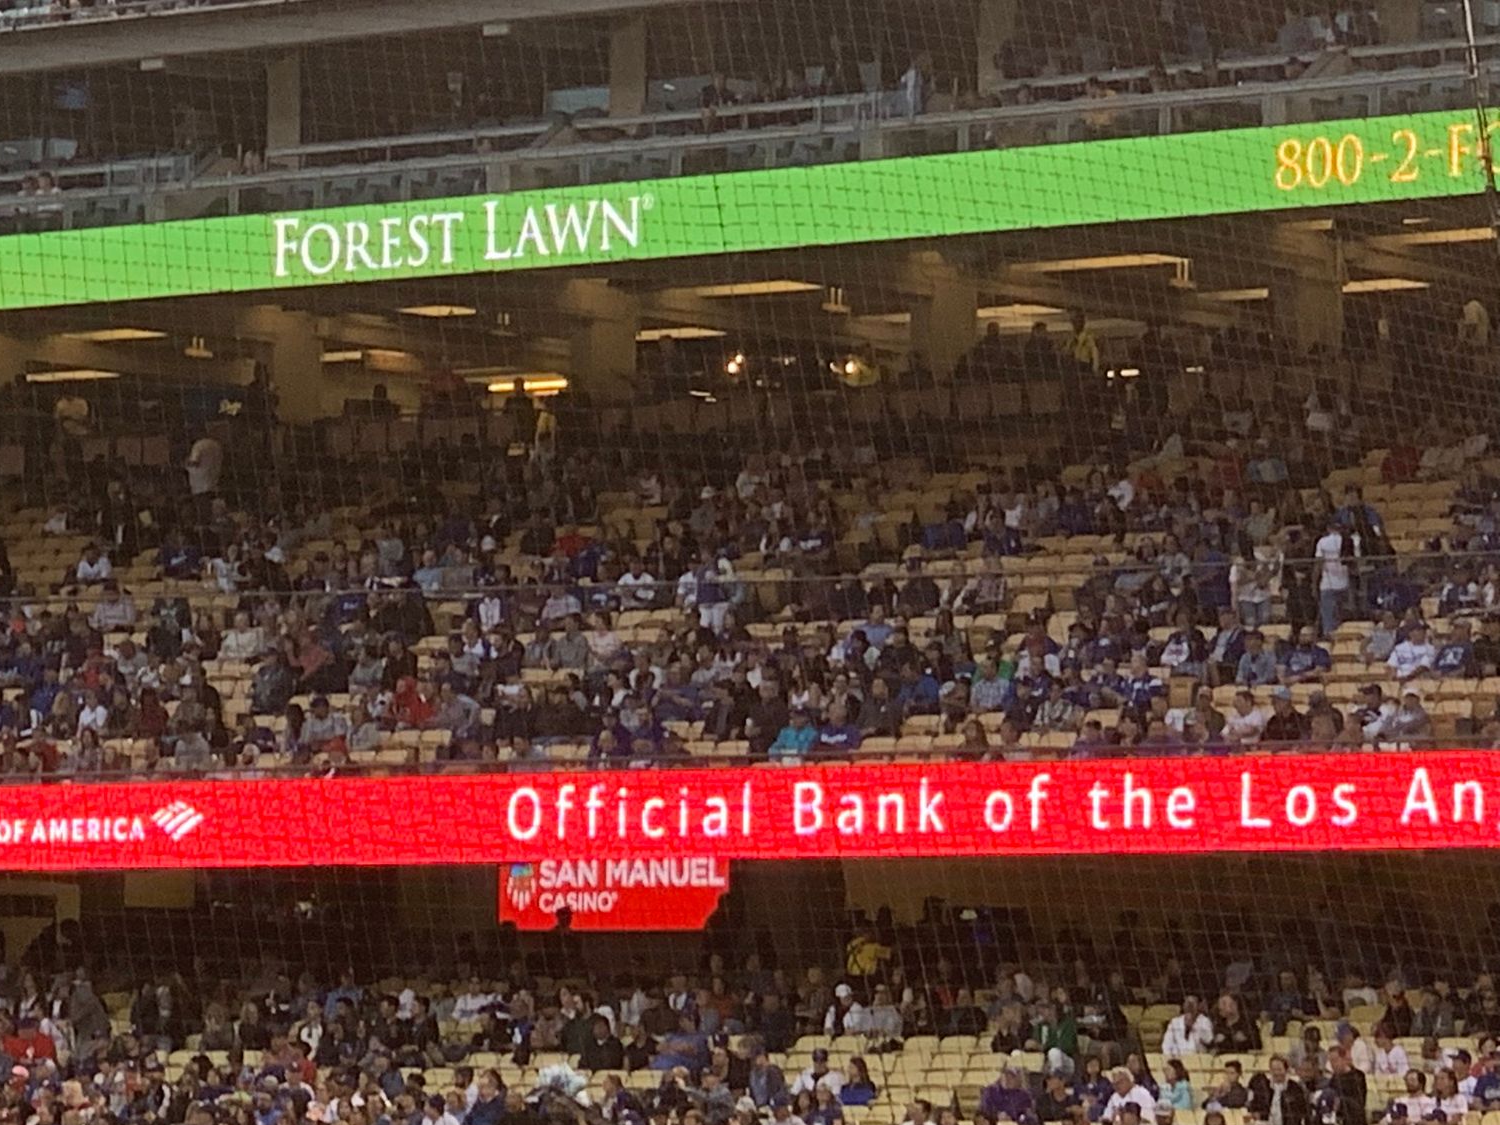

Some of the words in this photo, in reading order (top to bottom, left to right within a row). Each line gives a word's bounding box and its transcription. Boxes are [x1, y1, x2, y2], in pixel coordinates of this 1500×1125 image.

[273, 211, 464, 278] FOREST
[30, 816, 146, 843] AMERICA
[506, 779, 753, 842] Official
[792, 776, 947, 836] Bank
[983, 772, 1051, 833] of
[1087, 771, 1197, 831] the
[1239, 770, 1359, 828] Los
[538, 858, 599, 889] SAN
[606, 857, 726, 889] MANUEL
